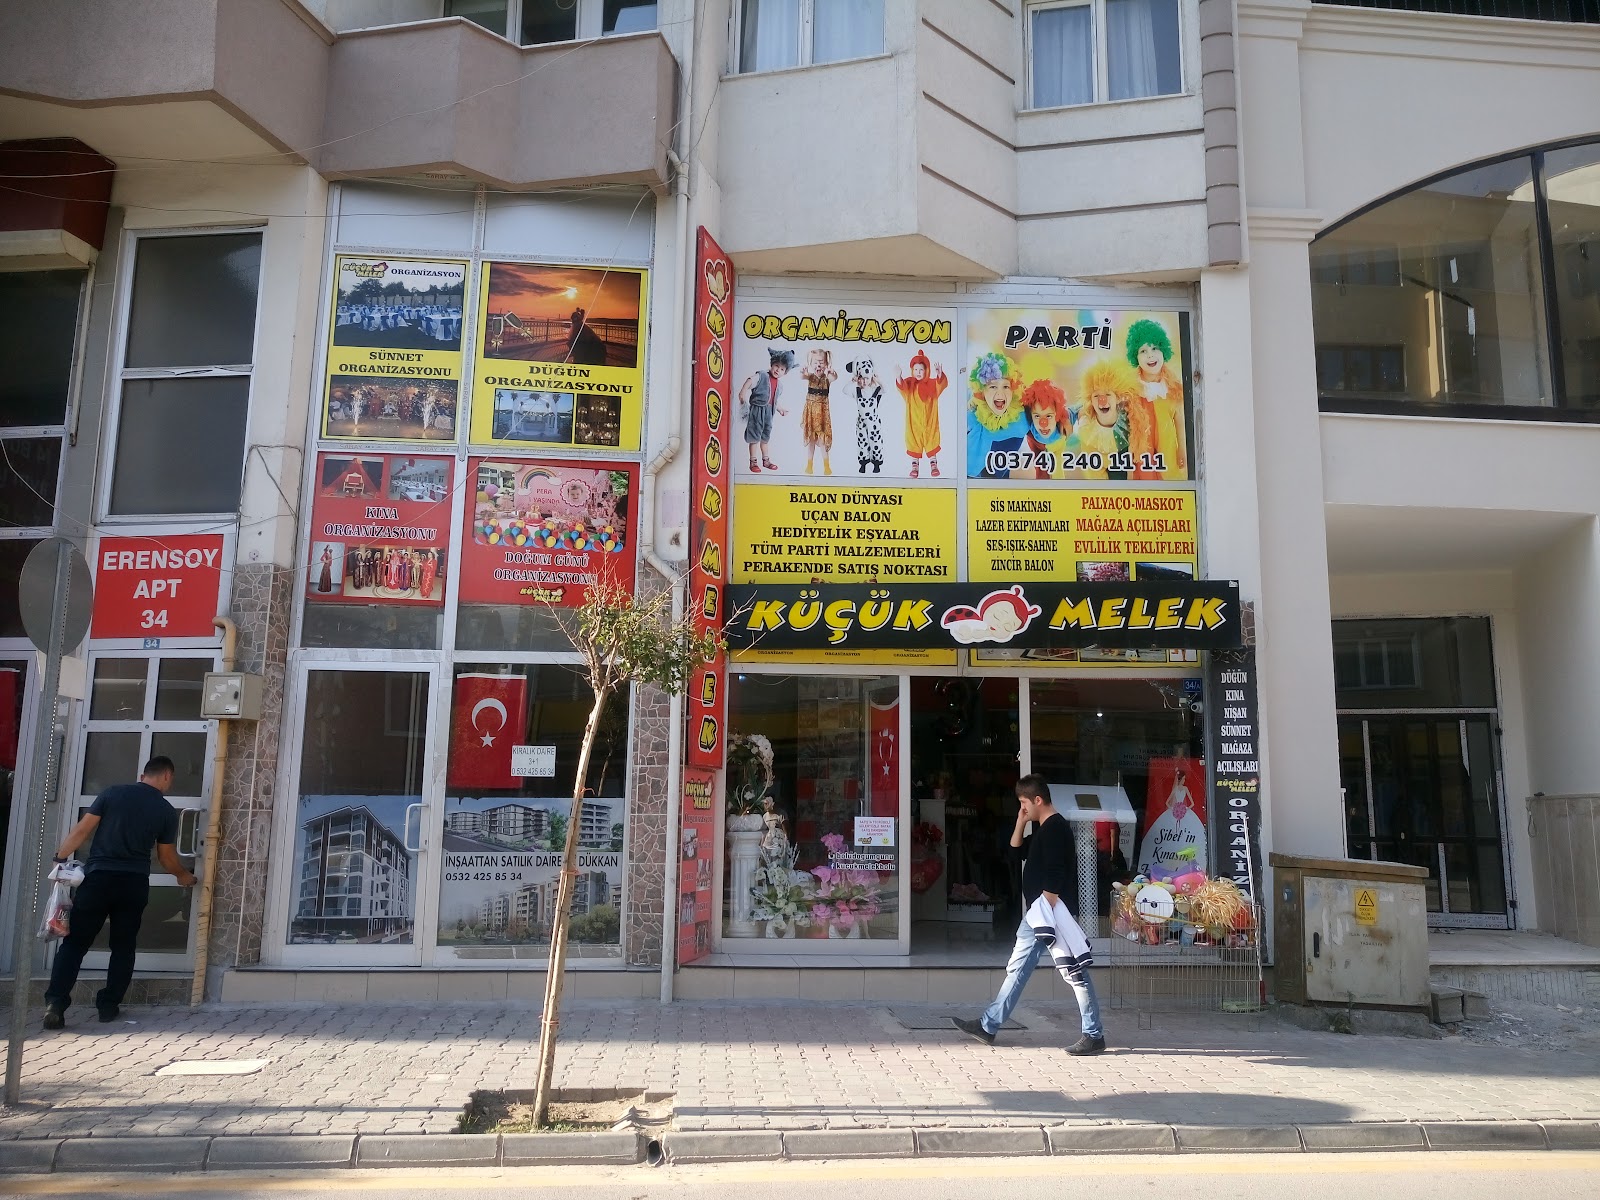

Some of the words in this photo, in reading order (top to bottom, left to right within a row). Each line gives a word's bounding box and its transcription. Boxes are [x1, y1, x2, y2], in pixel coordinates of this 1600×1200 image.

[342, 263, 373, 274] KÜÇÜK
[391, 268, 461, 278] ORGANİZASYON
[743, 310, 952, 343] ORGANİZASYON
[1004, 317, 1112, 350] PARTİ
[369, 350, 424, 362] SÜNNET
[339, 363, 451, 377] ORGANİZASYONU
[529, 365, 590, 378] DÜĞÜN
[484, 376, 633, 394] ORGANİZASYONU
[987, 452, 1055, 473] (0374)
[1062, 453, 1102, 470] 240
[1109, 453, 1135, 470] 11
[1141, 454, 1167, 471] 11
[790, 492, 837, 504] BALON
[842, 491, 903, 506] DÜNYASI
[990, 497, 1004, 513] SİS
[1008, 497, 1052, 513] MAKİNASI
[1081, 496, 1184, 514] PALYAÇO-MASKOT
[366, 507, 398, 519] KINA
[801, 510, 839, 524] UÇAN
[844, 511, 891, 523] BALON
[324, 522, 437, 540] ORGANİZASYONU
[976, 519, 1005, 532] LAZER
[1007, 517, 1070, 533] EKİPMANLARI
[1076, 515, 1124, 533] MAĞAZA
[1127, 519, 1191, 536] AÇILIŞLARI
[771, 525, 852, 540] HEDİYELİK
[856, 529, 920, 542] EŞYALAR
[751, 541, 783, 555] TÜM
[787, 543, 830, 556] PARTİ
[834, 545, 941, 559] MALZEMELERİ
[986, 539, 1058, 555] SES-IŞIK-SAHNE
[1074, 537, 1121, 554] EVLİLİK
[1124, 538, 1195, 555] TEKLİFLERİ
[103, 549, 219, 571] ERENSOY
[504, 550, 552, 565] DOĞUM
[555, 552, 590, 567] GÜNÜ
[991, 556, 1022, 571] ZİNCİR
[1024, 559, 1054, 571] BALON
[743, 562, 833, 574] PERAKENDE
[838, 564, 879, 577] SATIŞ
[883, 565, 948, 576] NOKTASI
[133, 579, 182, 599] APT
[140, 610, 168, 629] 34
[746, 589, 933, 645] KÜÇÜK
[1049, 597, 1227, 631] MELEK
[145, 639, 158, 648] 34
[1221, 669, 1248, 684] DÜĞÜN
[1225, 690, 1245, 701] KINA
[1224, 704, 1247, 722] NİŞAN
[1221, 721, 1252, 737] SÜNNET
[512, 747, 536, 755] KİRALIK
[1221, 740, 1253, 754] MAĞAZA
[528, 757, 539, 765] 3+1
[1216, 761, 1258, 775] AÇILIŞLARI
[511, 768, 516, 776] 0
[516, 768, 527, 776] 532
[445, 852, 498, 869] İNŞAATTAN
[500, 855, 533, 867] SATILIK
[535, 853, 562, 867] DAİRE
[578, 852, 618, 867] DÜKKAN
[445, 872, 470, 881] 0532
[473, 872, 492, 881] 425
[495, 872, 507, 881] 85
[510, 872, 522, 881] 34
